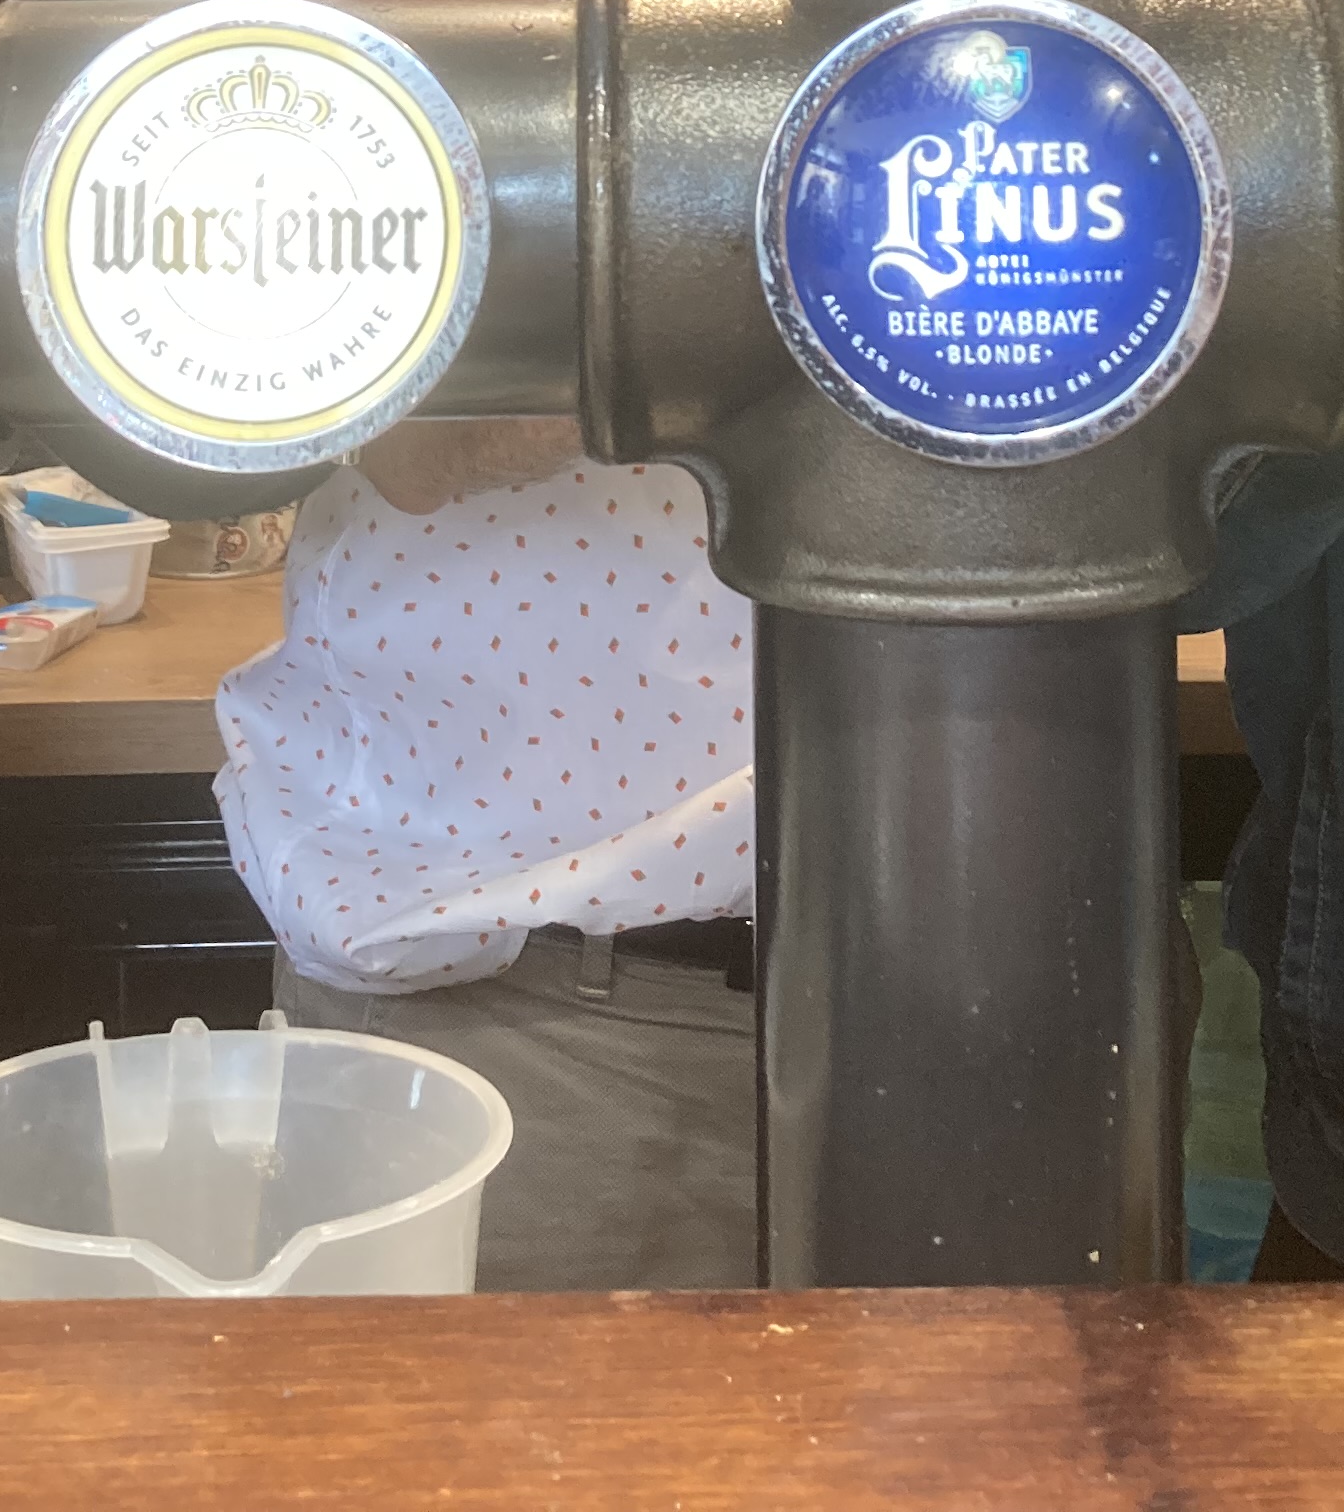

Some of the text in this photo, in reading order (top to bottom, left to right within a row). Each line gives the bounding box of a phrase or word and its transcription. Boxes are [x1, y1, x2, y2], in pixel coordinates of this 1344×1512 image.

[122, 111, 396, 169] SEIT 1753
[952, 119, 1090, 186] PATER
[88, 173, 429, 288] Warsteiner
[868, 134, 1126, 302] LINUS
[120, 304, 393, 392] DAS EINZIG WAHRE
[821, 294, 849, 333] ALC.
[897, 368, 937, 399] VOL.
[965, 386, 1057, 409] BRASSÉE
[1066, 370, 1092, 393] EN
[1098, 286, 1171, 374] BELGIQUE
[887, 303, 1099, 337] BIÈRE D'ABBAYE
